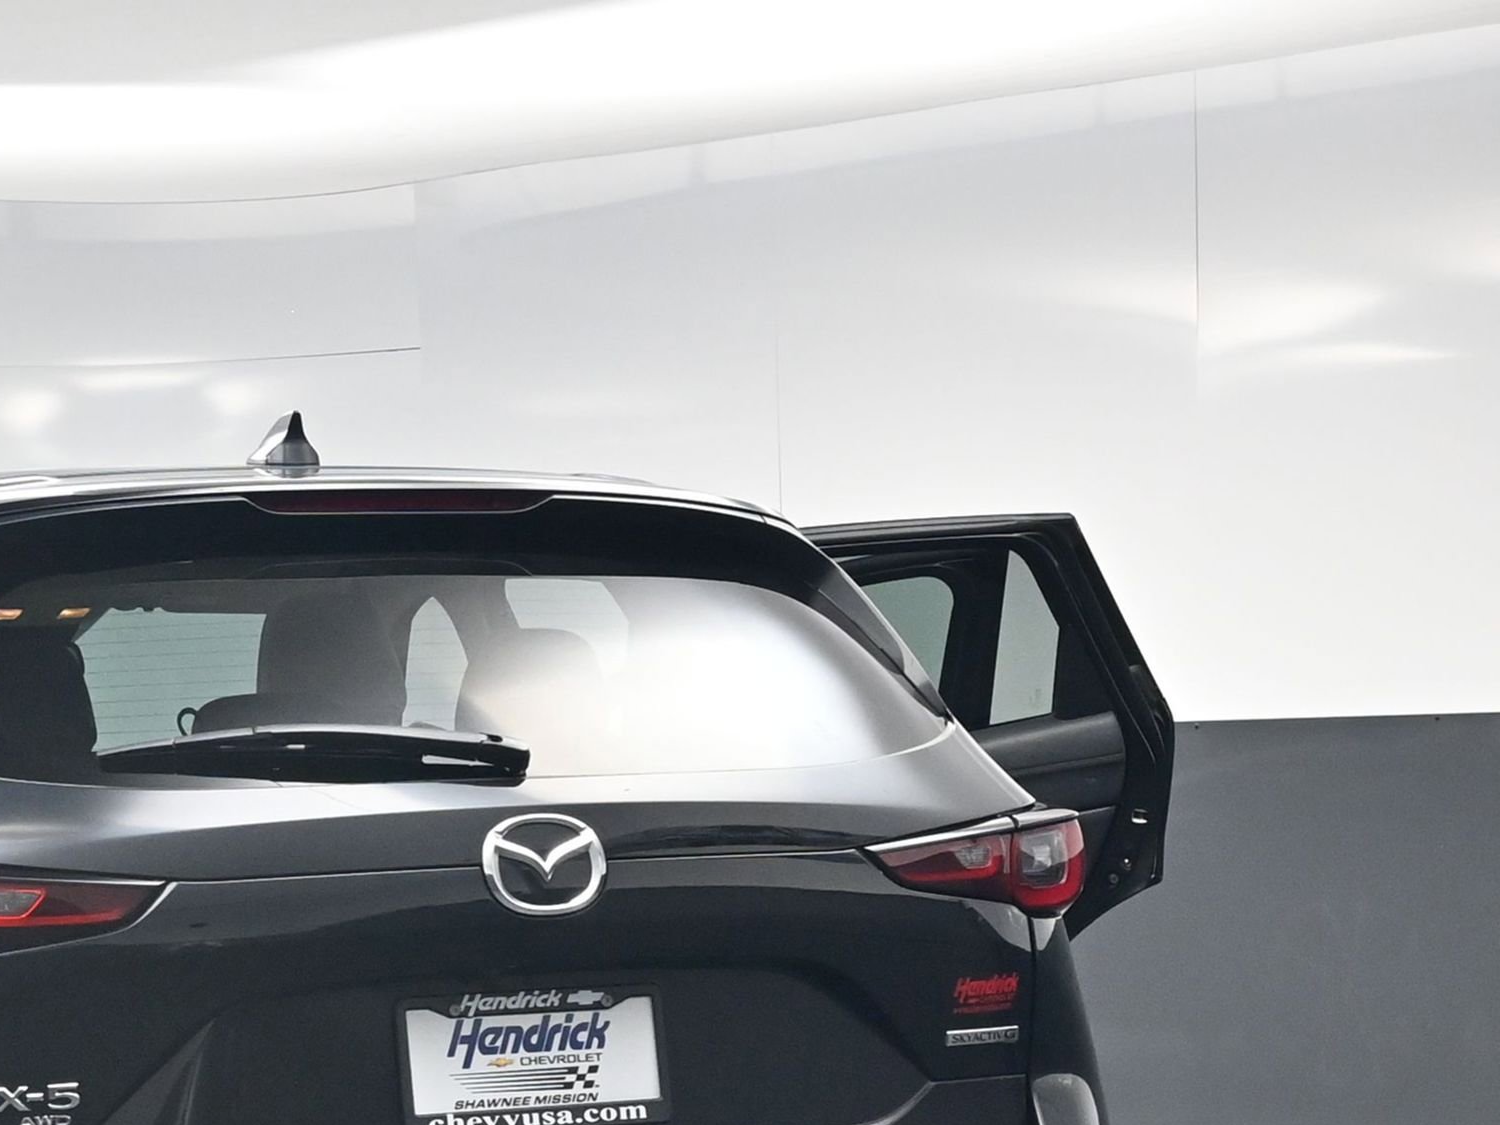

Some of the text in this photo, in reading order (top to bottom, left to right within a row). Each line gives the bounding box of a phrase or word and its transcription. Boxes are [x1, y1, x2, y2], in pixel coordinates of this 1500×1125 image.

[460, 990, 562, 1017] Hendrick
[447, 1012, 610, 1069] Hendrick
[520, 1052, 603, 1066] CHEVROLET
[454, 1092, 599, 1111] SHAWNEE MISSION
